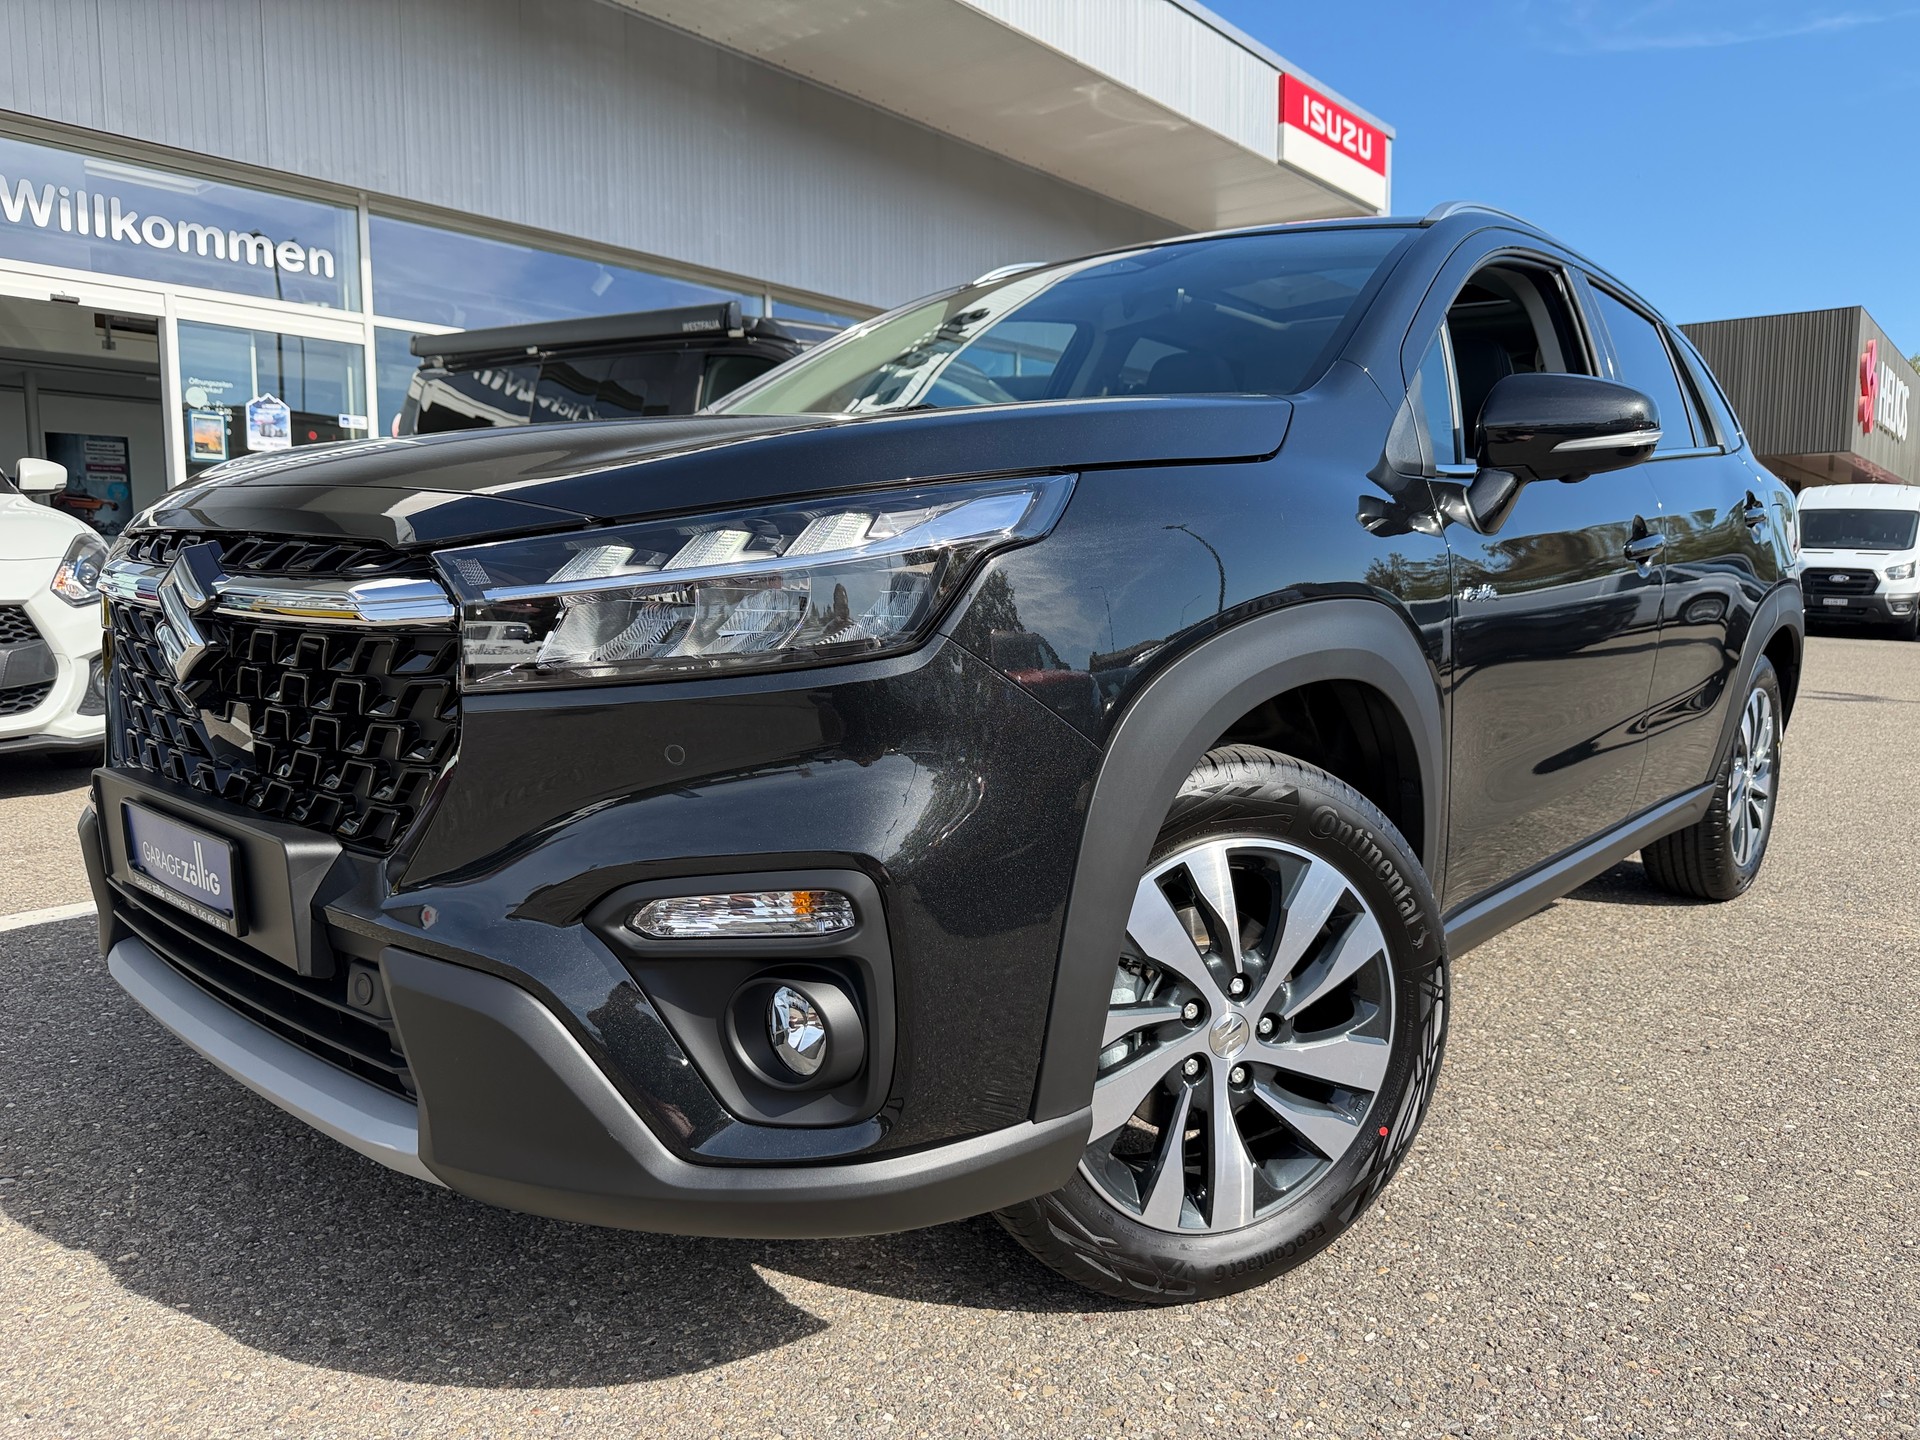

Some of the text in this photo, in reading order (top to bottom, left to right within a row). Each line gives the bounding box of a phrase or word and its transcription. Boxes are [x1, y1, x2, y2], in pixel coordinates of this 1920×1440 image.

[1303, 94, 1372, 161] ISUZU
[0, 174, 335, 279] Willkommen
[682, 319, 721, 332] WESTFALIA
[1878, 361, 1910, 442] HELIOS
[1308, 805, 1425, 929] Continental
[1214, 1265, 1227, 1282] 6
[1230, 1221, 1327, 1279] EcoContact
